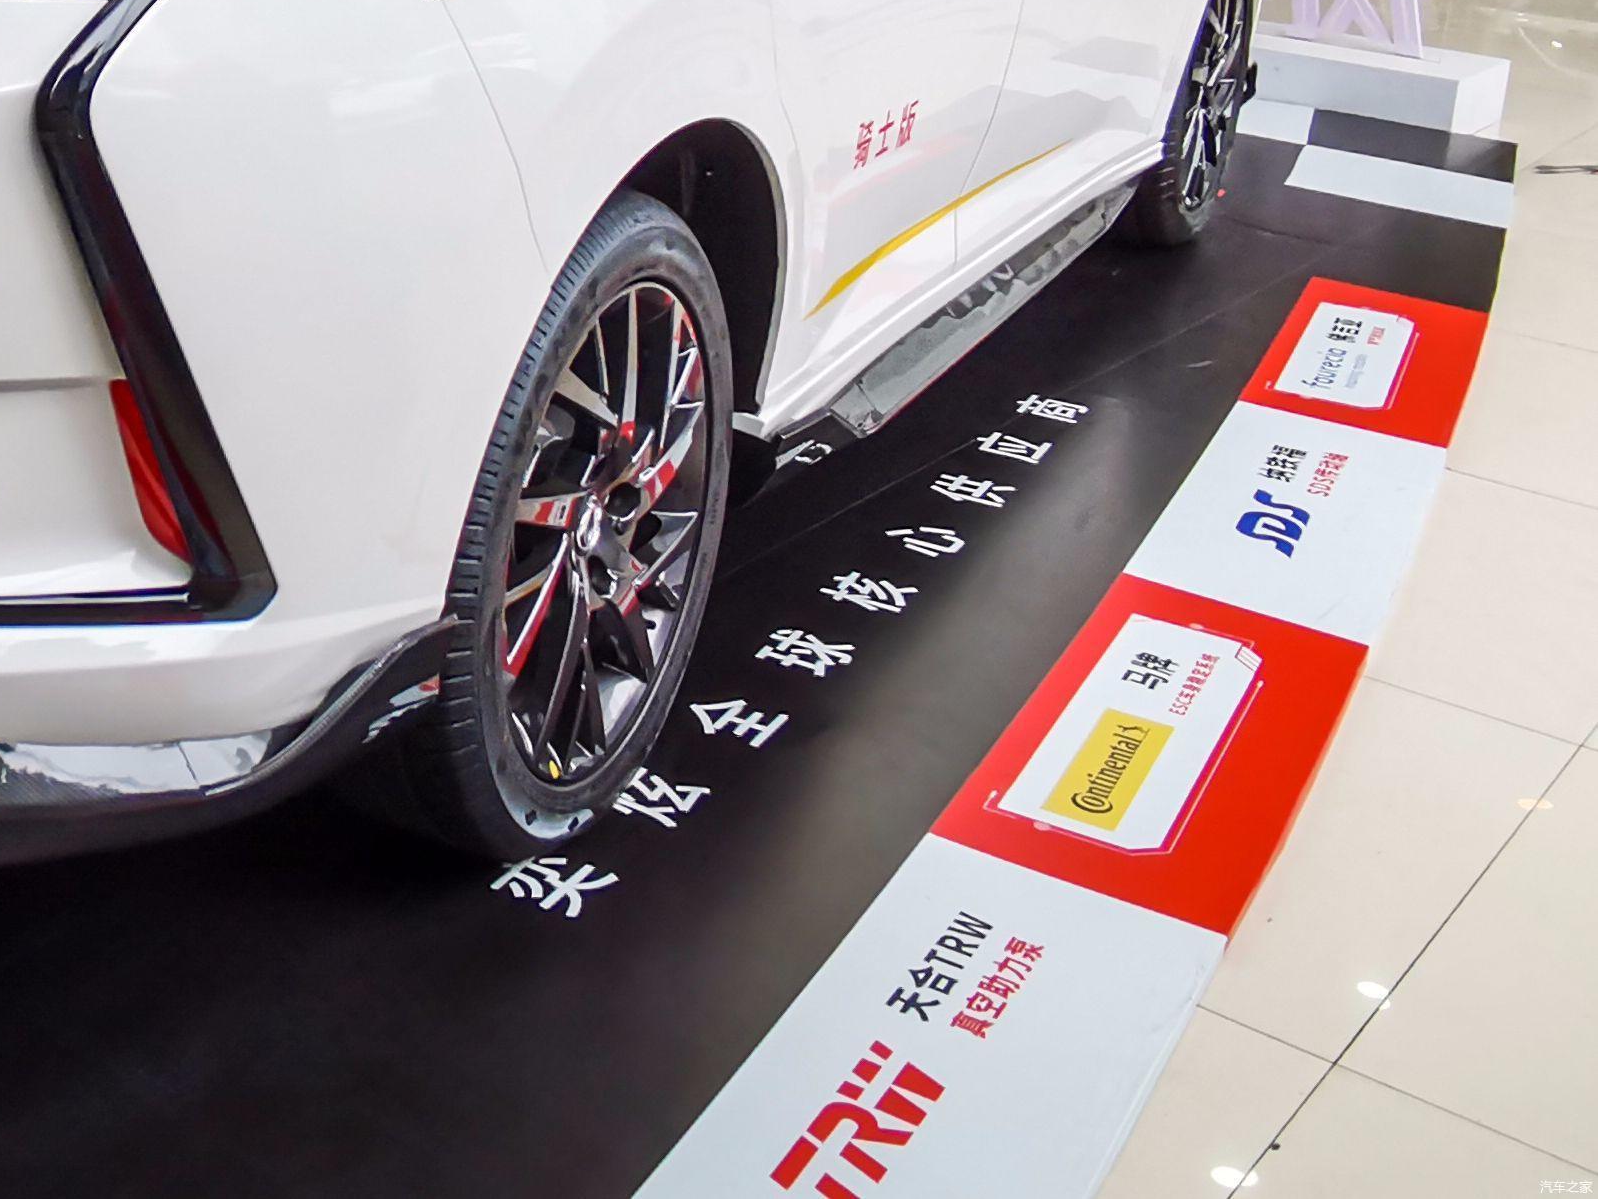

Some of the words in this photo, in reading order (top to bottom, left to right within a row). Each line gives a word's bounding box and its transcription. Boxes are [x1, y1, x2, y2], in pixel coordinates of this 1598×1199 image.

[853, 100, 920, 170] 骑士版
[490, 393, 1090, 918] 奕炫全球核心供应商
[1121, 651, 1180, 691] 马牌
[1070, 732, 1143, 815] Continental
[950, 936, 1046, 1040] 真空助力泵
[769, 1040, 947, 1199] TRW
